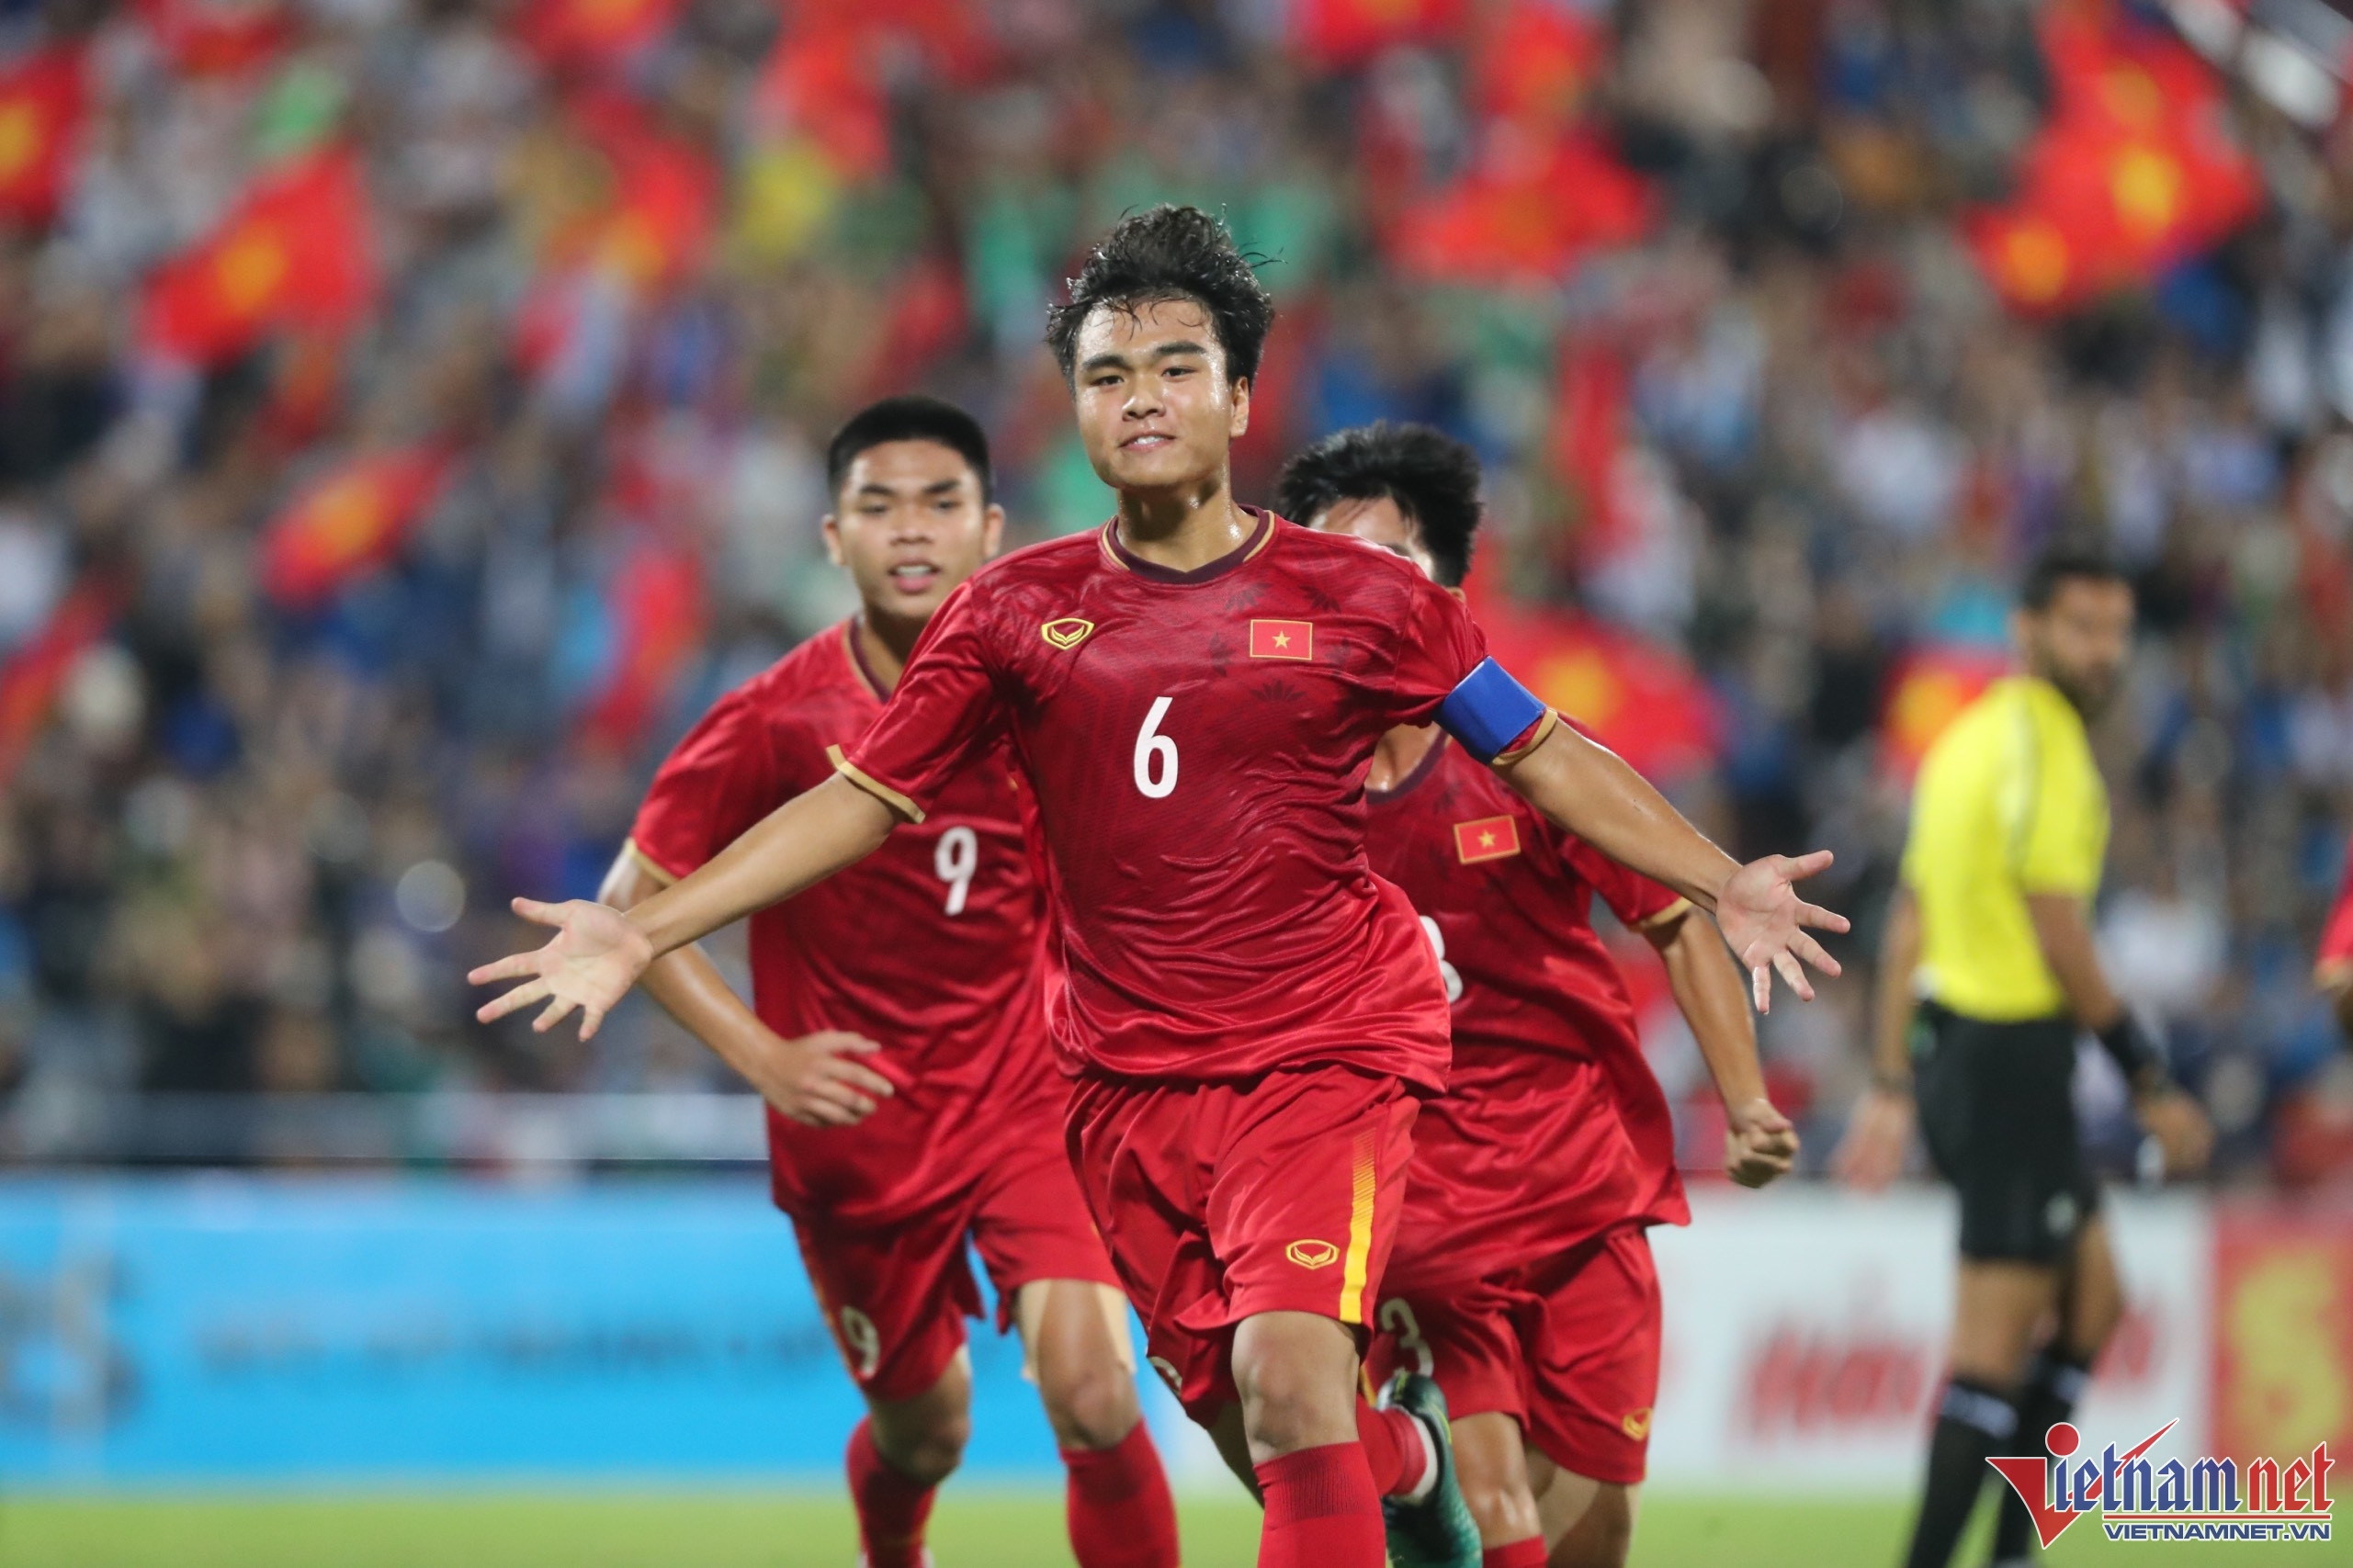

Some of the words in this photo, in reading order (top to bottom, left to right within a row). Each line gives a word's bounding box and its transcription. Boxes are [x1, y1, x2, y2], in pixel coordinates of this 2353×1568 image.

[1134, 696, 1179, 798] 6
[934, 826, 978, 916] 9
[841, 1305, 880, 1379] 9
